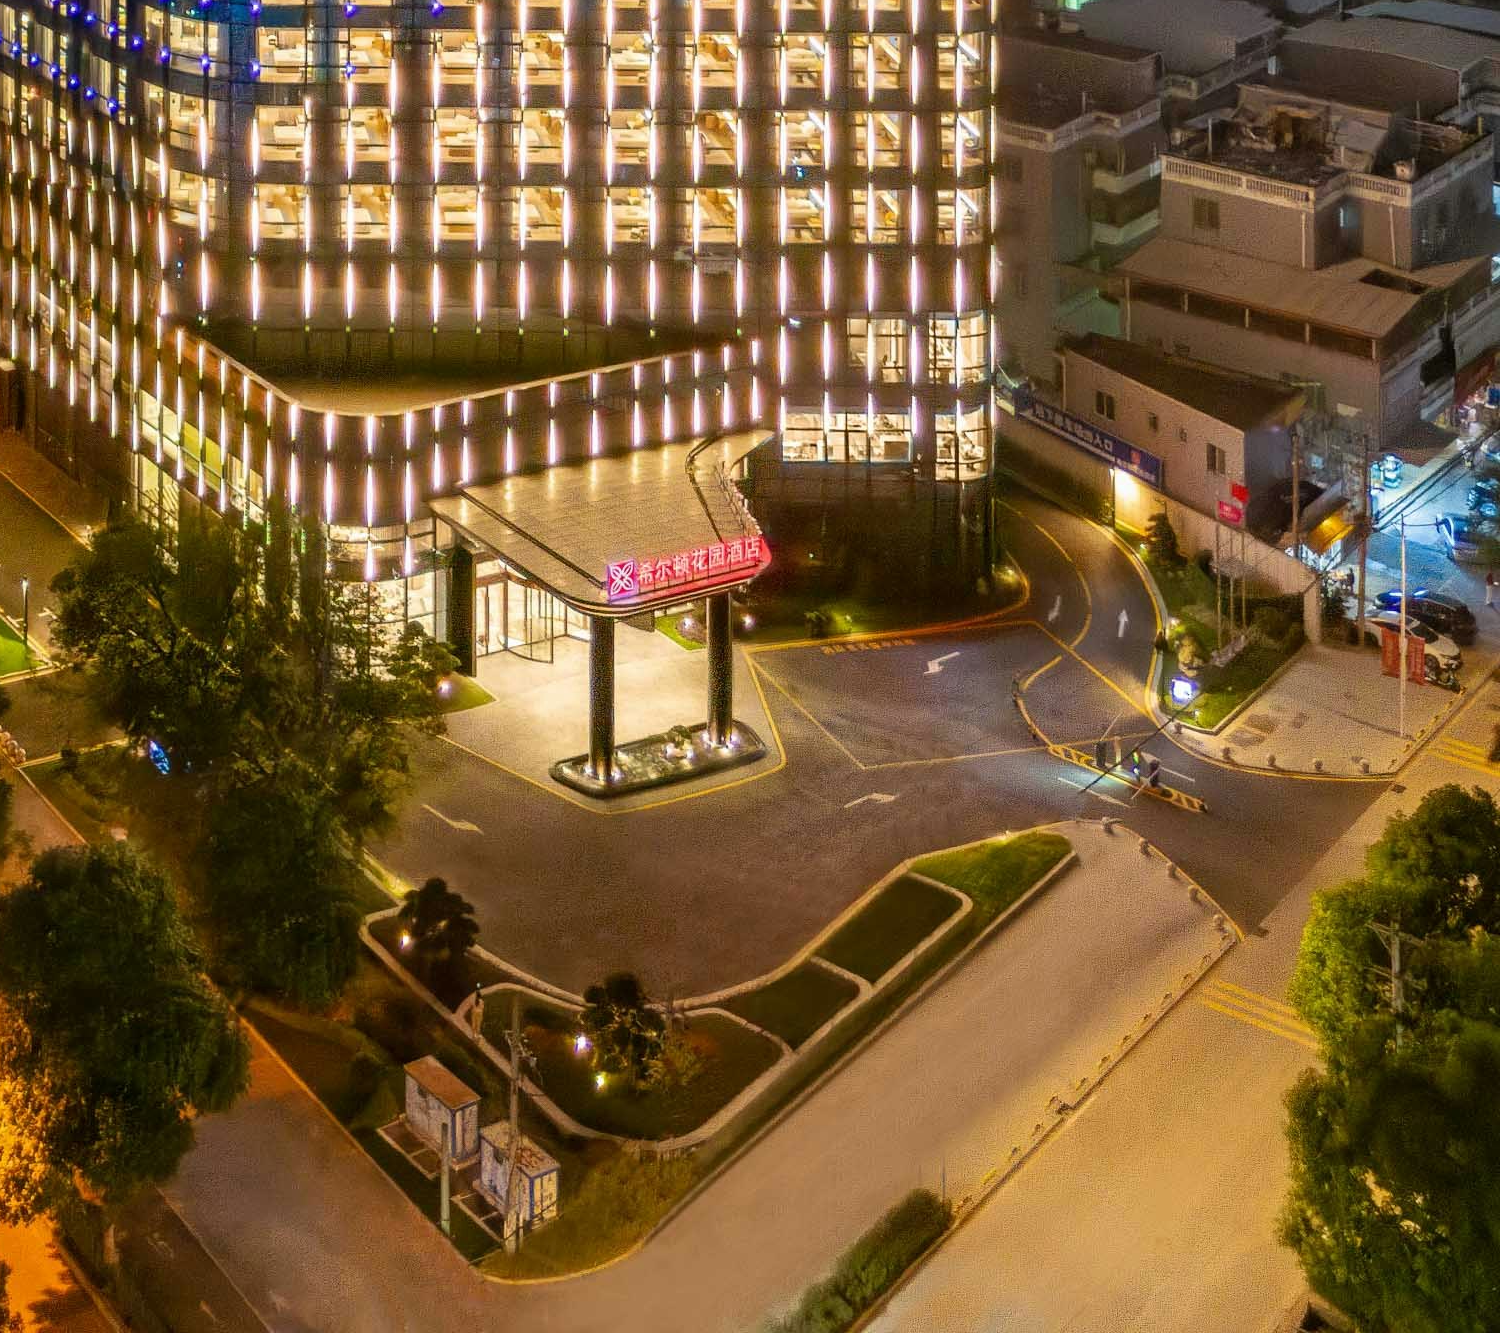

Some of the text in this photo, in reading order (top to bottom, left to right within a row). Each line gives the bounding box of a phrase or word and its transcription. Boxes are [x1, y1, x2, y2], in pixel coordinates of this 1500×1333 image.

[639, 536, 760, 584] 希尔顿花园酒店
